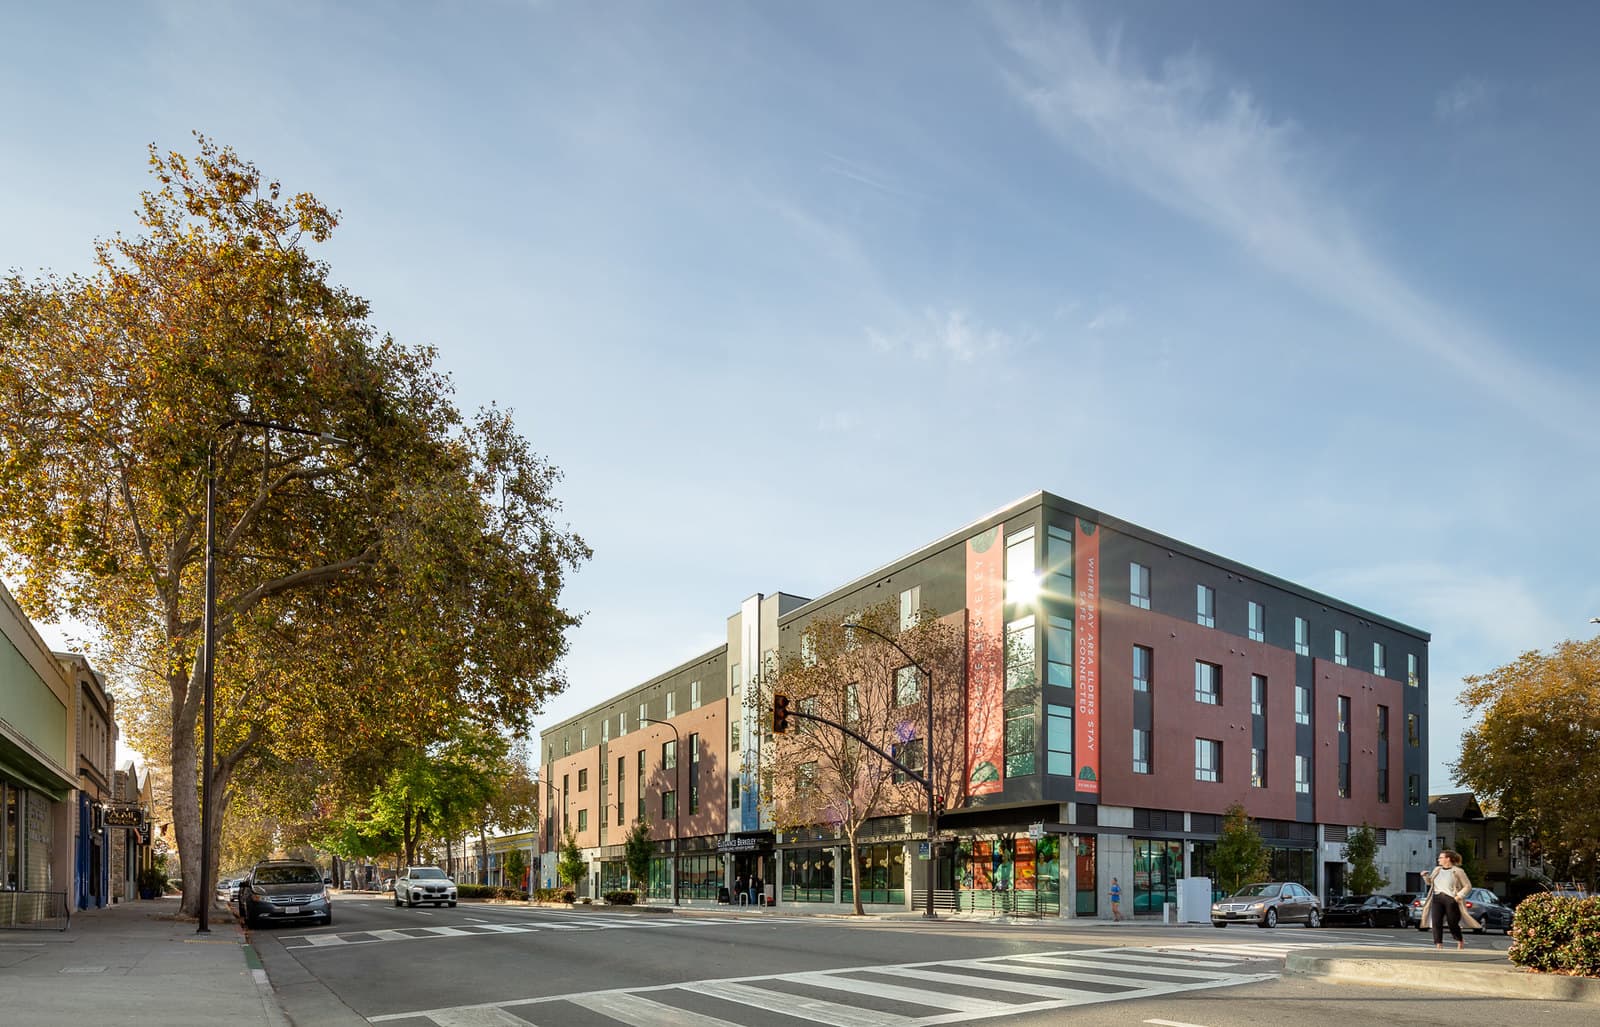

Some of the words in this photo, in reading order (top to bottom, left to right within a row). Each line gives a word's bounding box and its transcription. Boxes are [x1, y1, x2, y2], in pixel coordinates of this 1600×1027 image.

[1087, 557, 1095, 600] WHERE
[974, 560, 983, 652] BERKELEY
[1087, 604, 1095, 629] BAY
[1087, 632, 1095, 665] AREA
[1087, 670, 1095, 716] ELDERS
[1087, 720, 1095, 751] STAY
